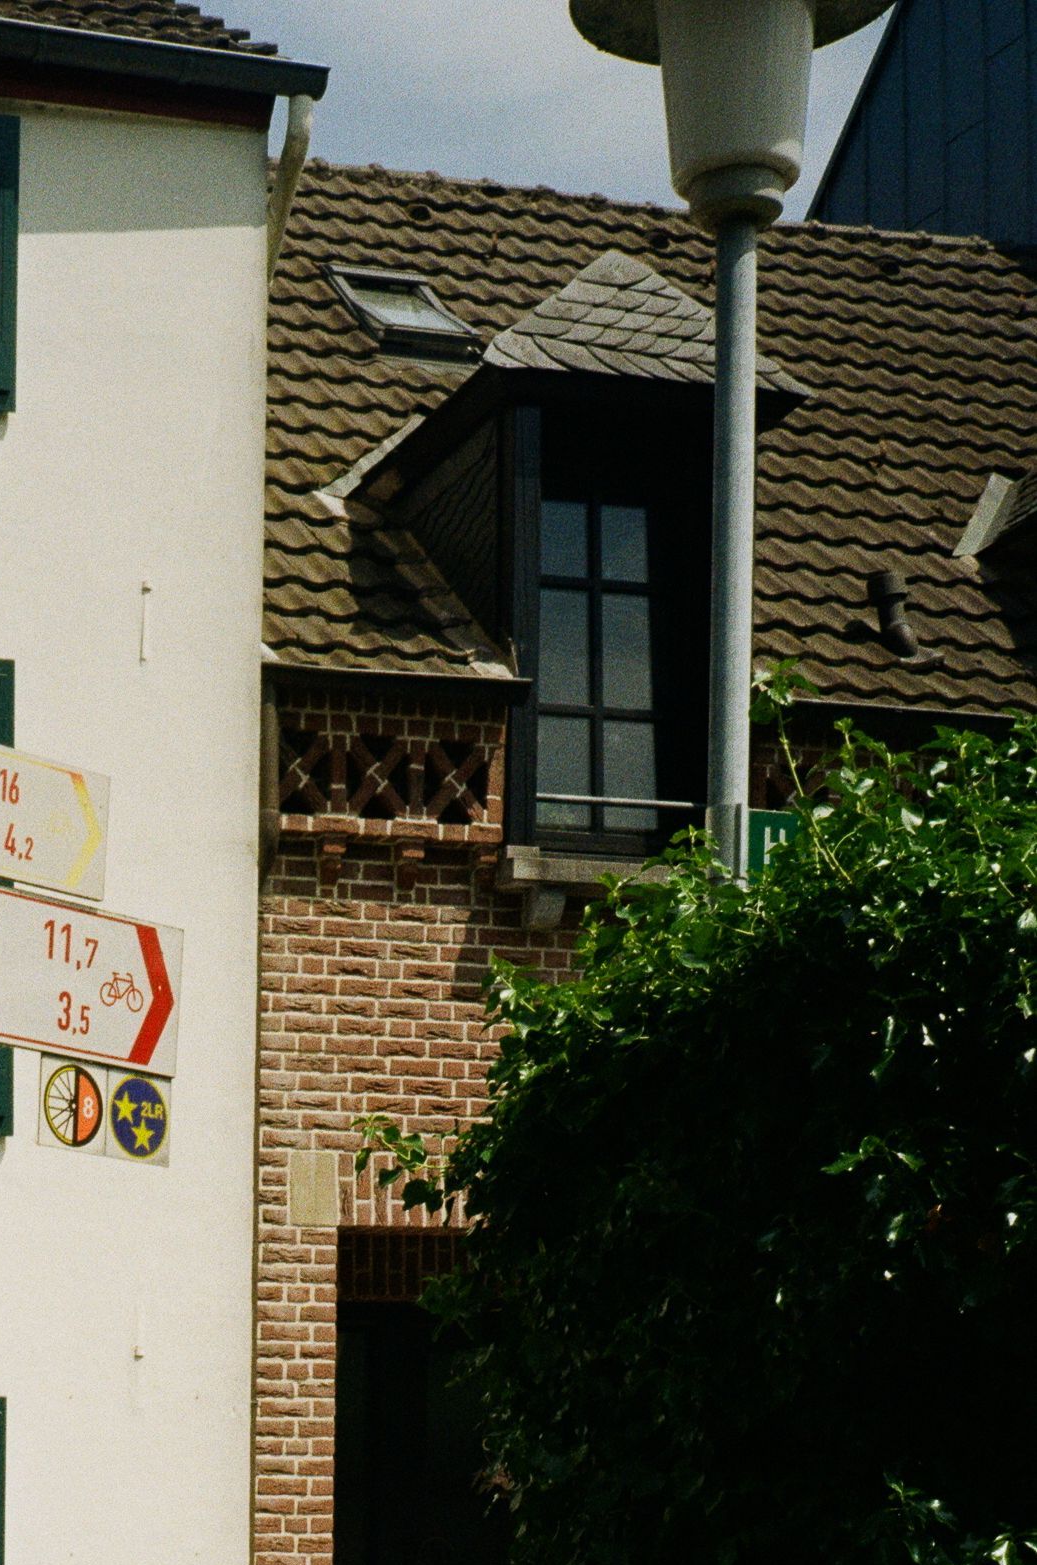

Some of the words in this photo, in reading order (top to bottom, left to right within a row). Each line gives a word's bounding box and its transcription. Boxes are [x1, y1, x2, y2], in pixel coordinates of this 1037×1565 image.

[0, 768, 20, 804] 16
[4, 823, 34, 861] 4,2
[44, 919, 99, 971] 11,7
[57, 991, 91, 1035] 3,5
[83, 1096, 94, 1119] 8
